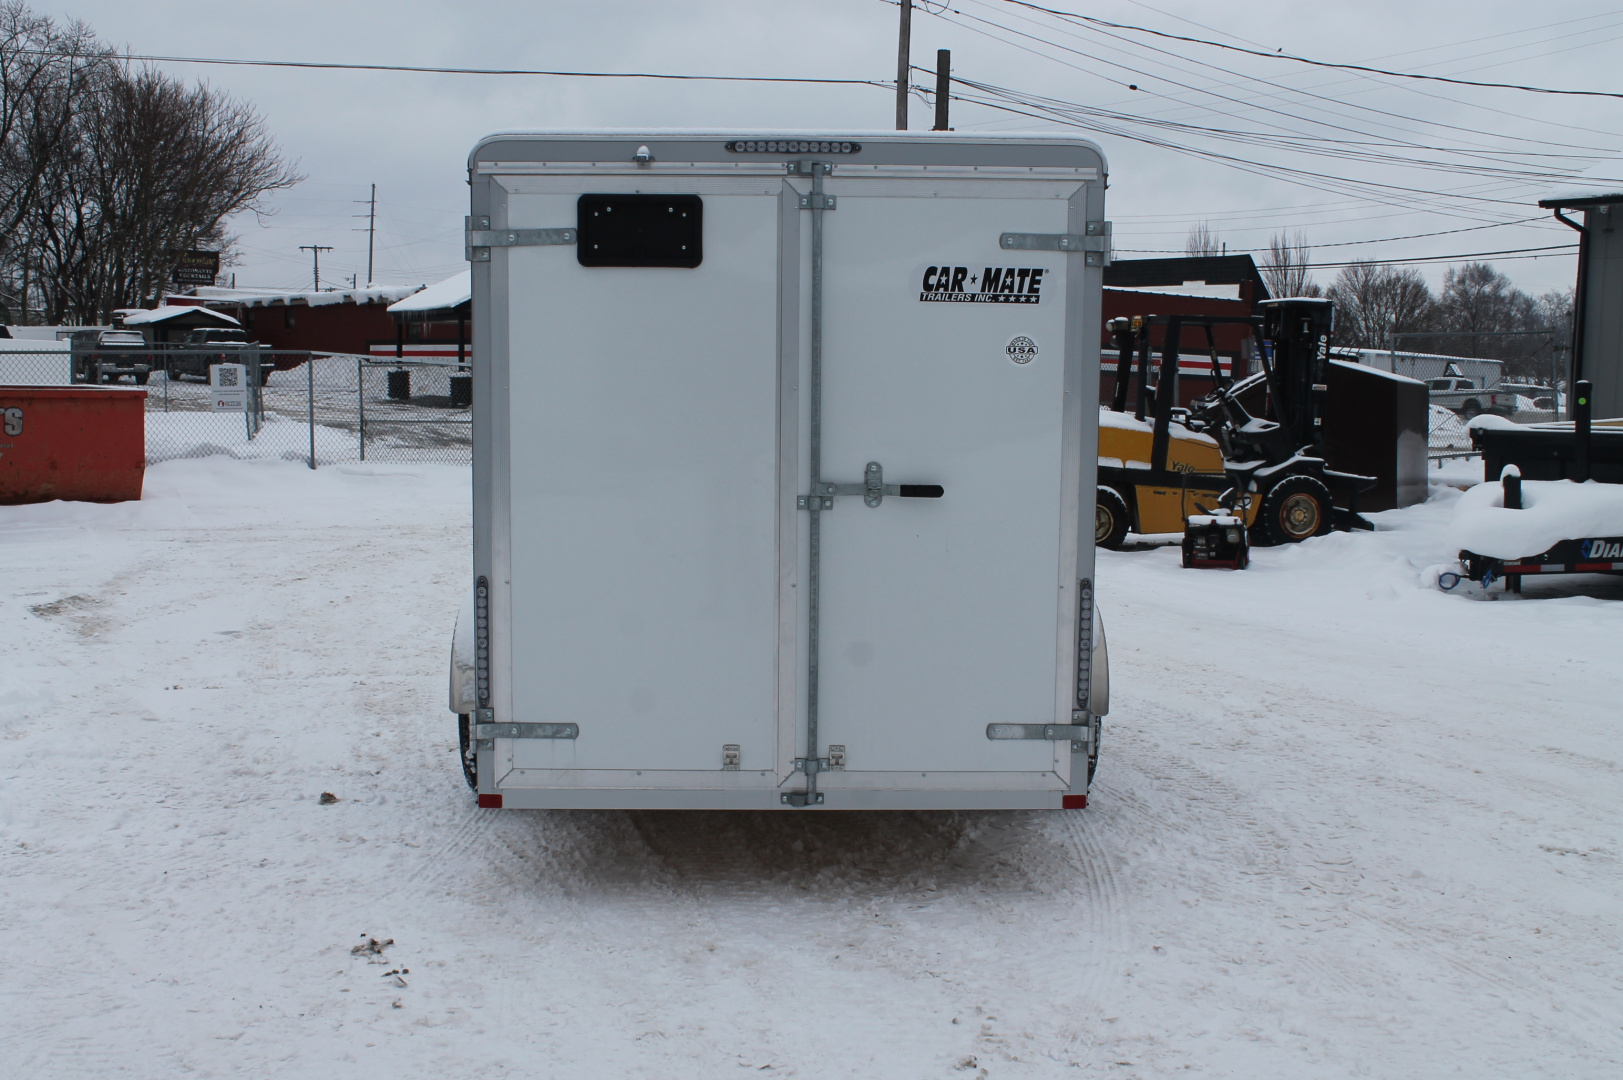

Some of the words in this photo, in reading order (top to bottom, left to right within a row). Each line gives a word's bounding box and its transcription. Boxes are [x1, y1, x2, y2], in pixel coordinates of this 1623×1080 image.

[922, 266, 968, 293] CAR
[980, 267, 1044, 294] MATE
[921, 293, 971, 302] TRAILERS
[974, 294, 995, 303] INC.
[1317, 334, 1328, 360] Yale
[1172, 461, 1196, 473] Yale
